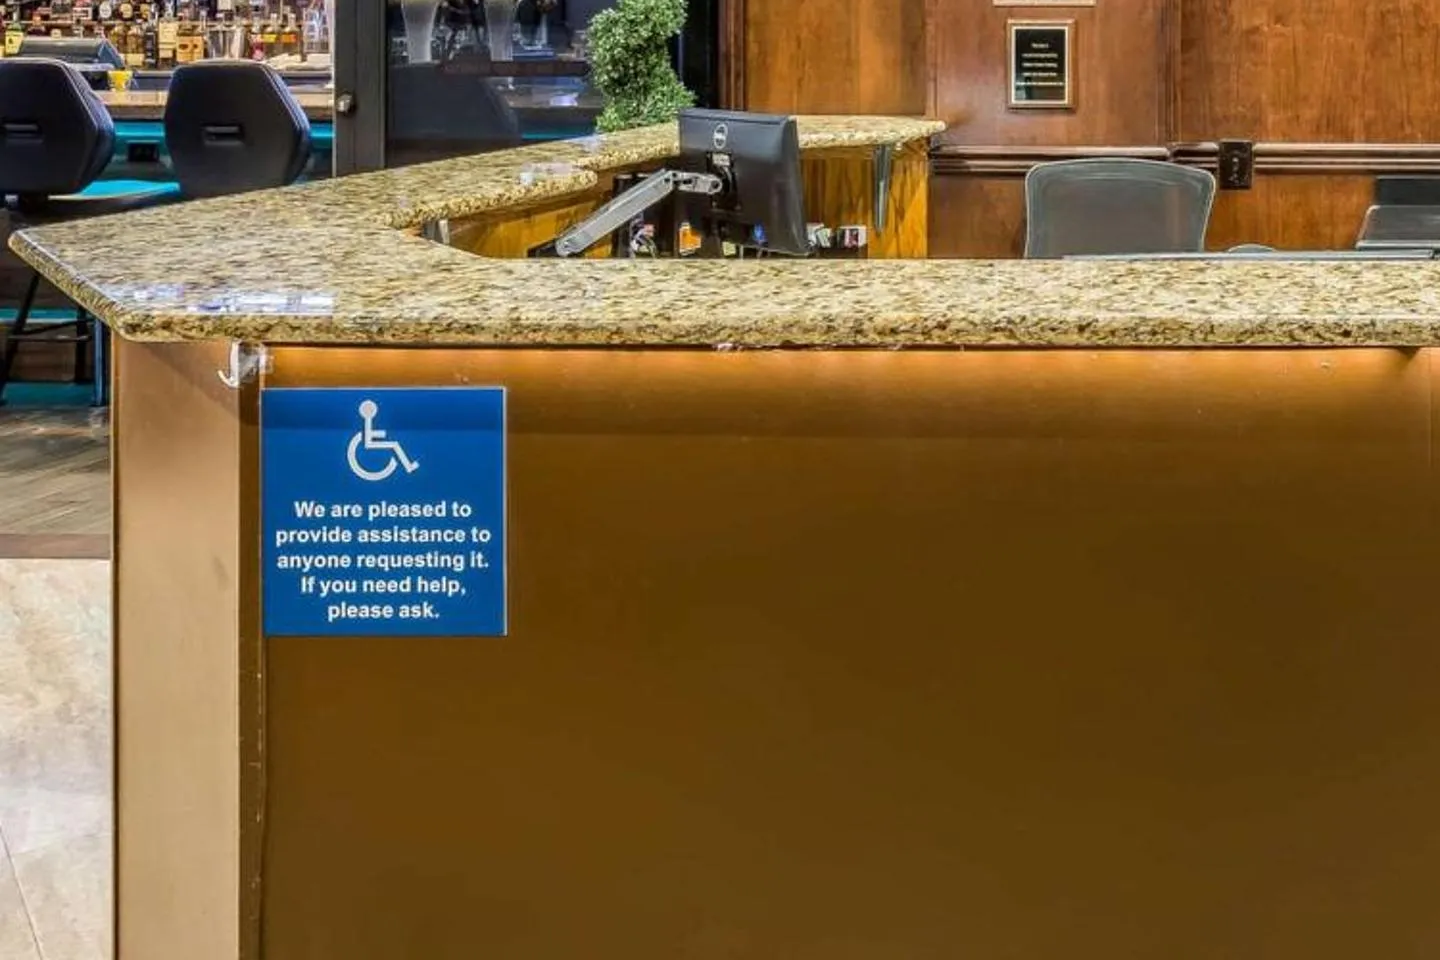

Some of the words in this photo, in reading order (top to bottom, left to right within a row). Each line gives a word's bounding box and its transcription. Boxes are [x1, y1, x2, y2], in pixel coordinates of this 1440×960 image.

[294, 501, 326, 518] We
[330, 504, 363, 518] are
[368, 500, 447, 521] pleased
[452, 501, 472, 518] to
[275, 525, 352, 547] provide
[357, 525, 466, 543] assistance
[471, 527, 491, 543] to
[277, 554, 352, 573] anyone
[356, 551, 465, 572] requesting
[470, 551, 489, 568] it.
[301, 576, 315, 593] If
[319, 579, 357, 597] you
[362, 576, 412, 593] need
[417, 575, 466, 597] help,
[327, 601, 394, 622] please
[398, 601, 440, 619] ask.
